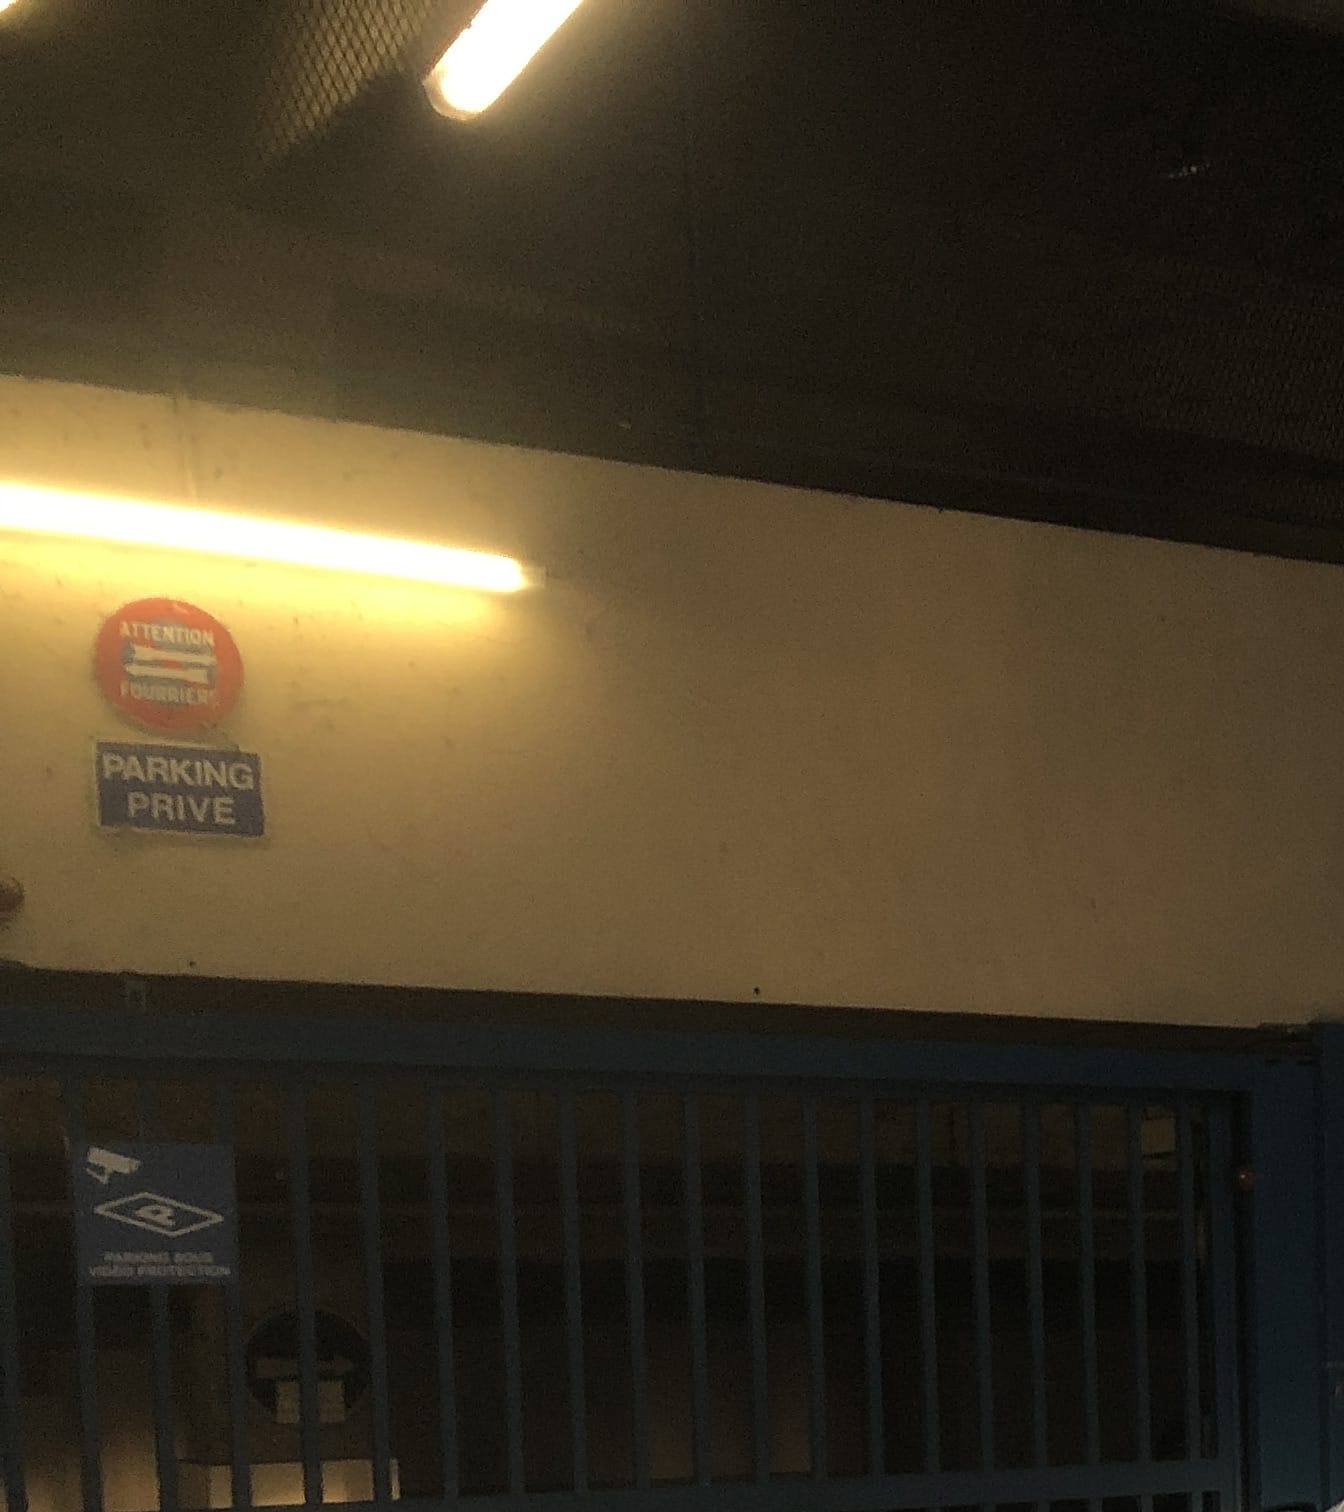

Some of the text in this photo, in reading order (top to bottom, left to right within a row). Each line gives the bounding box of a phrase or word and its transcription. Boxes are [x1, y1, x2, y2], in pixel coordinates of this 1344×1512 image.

[120, 621, 215, 646] ATTENTION
[102, 752, 254, 790] PARKING
[127, 791, 236, 825] PRIVE
